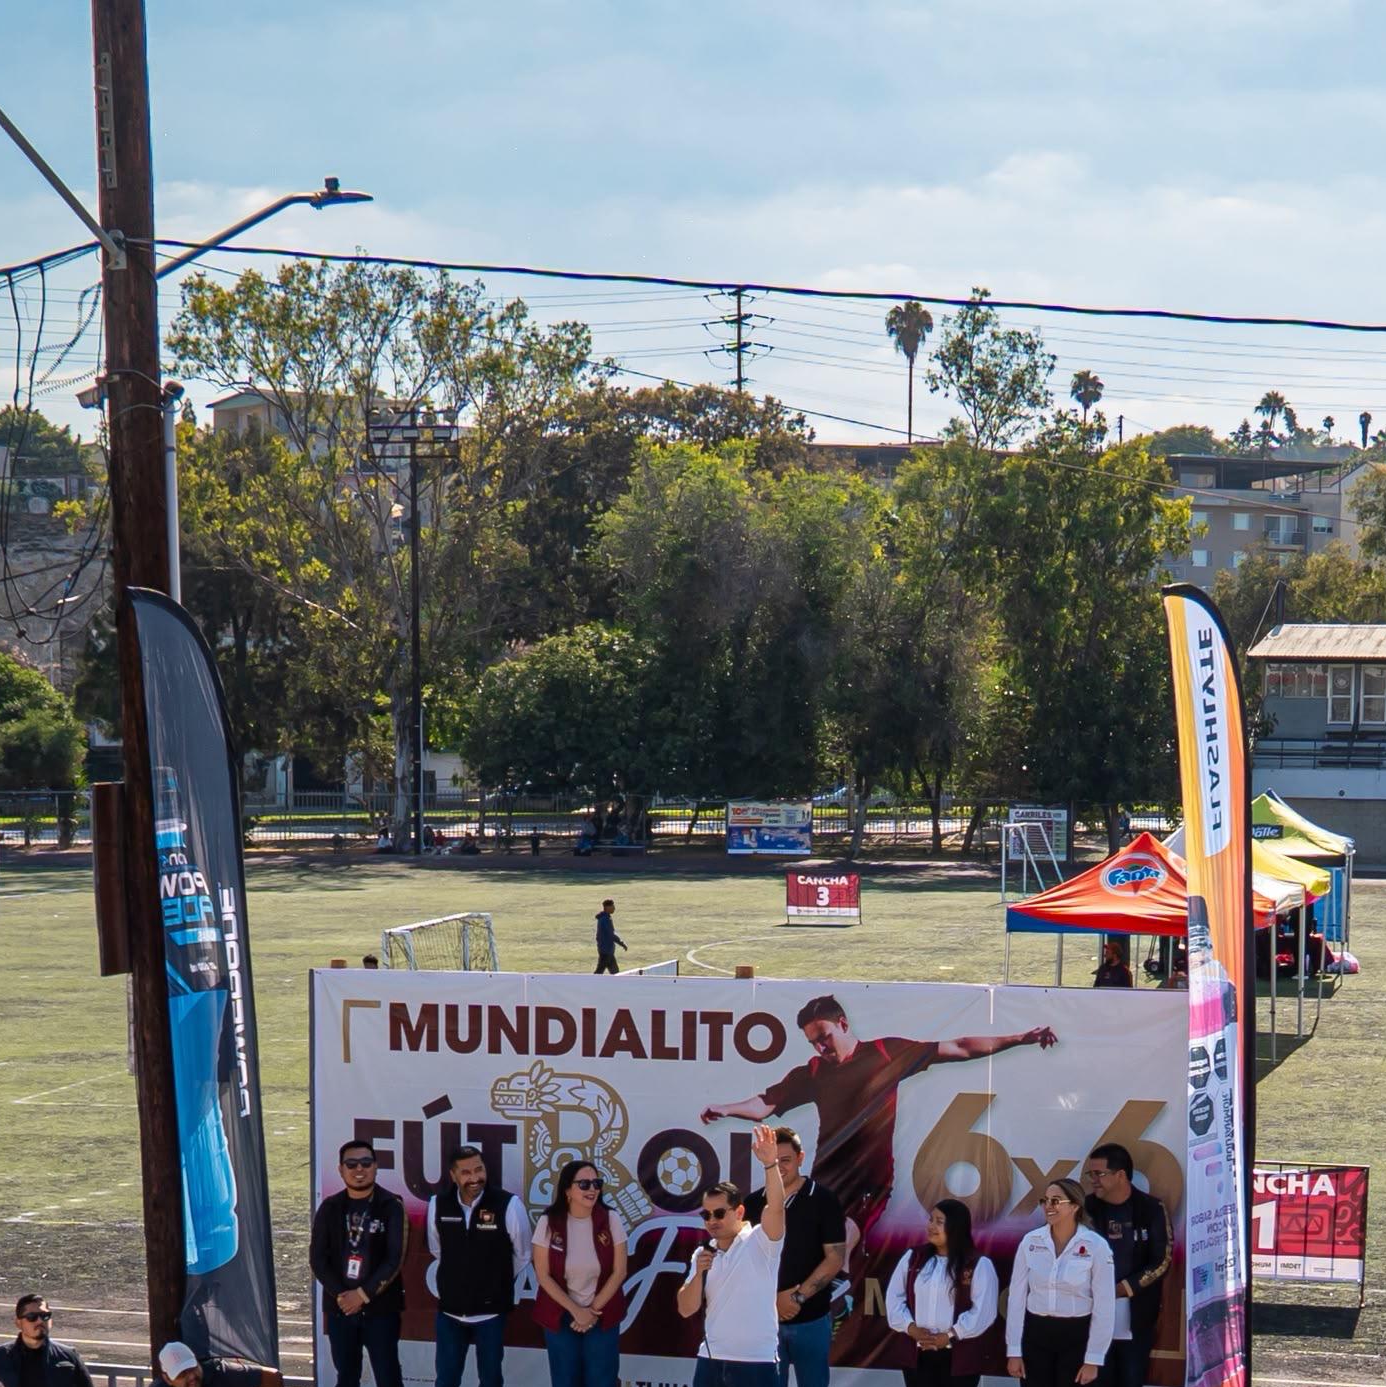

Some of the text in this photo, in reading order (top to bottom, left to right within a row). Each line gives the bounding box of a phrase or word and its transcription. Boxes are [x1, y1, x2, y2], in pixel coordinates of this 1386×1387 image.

[1252, 826, 1279, 838] alle
[797, 875, 848, 885] CANCHA
[1108, 864, 1161, 888] Fanta
[816, 886, 830, 906] 3
[389, 1002, 787, 1064] MUNDIALITO
[913, 1092, 1184, 1230] 6x6
[1253, 1173, 1336, 1196] NCHA
[1252, 1200, 1277, 1249] 1
